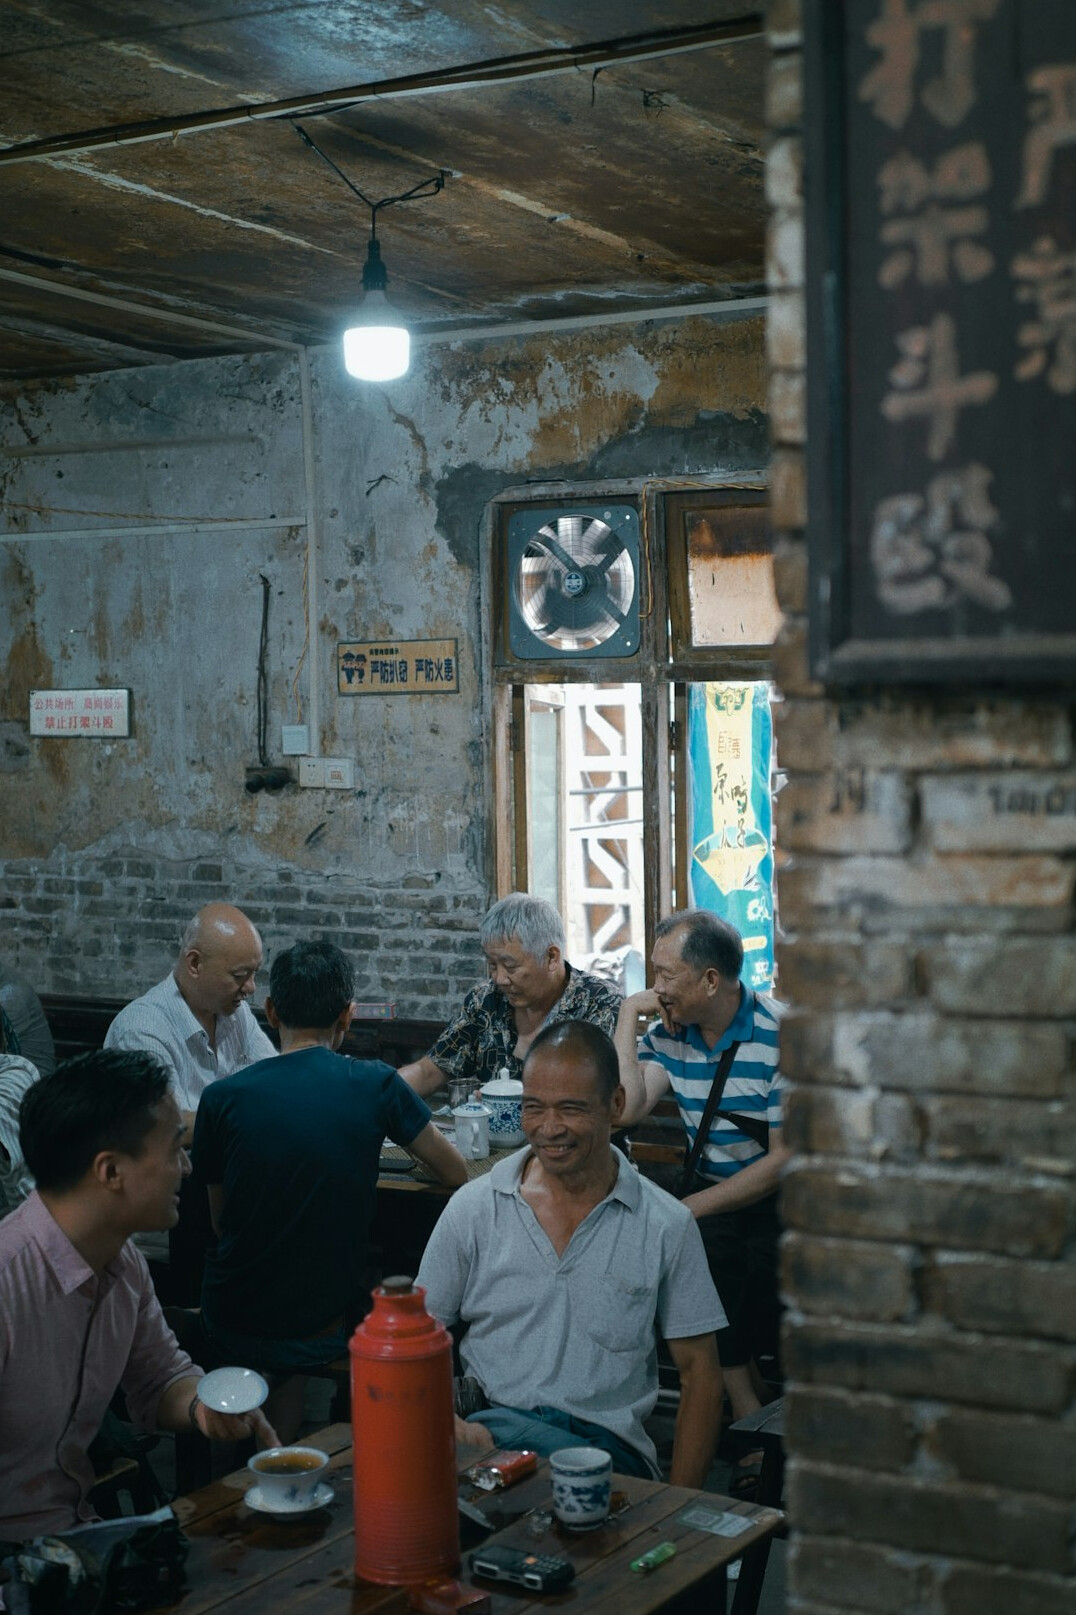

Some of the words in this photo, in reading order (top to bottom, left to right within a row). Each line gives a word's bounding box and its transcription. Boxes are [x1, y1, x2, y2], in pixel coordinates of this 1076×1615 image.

[34, 697, 75, 711] 公共场所
[45, 715, 114, 729] 禁止打架斗殴
